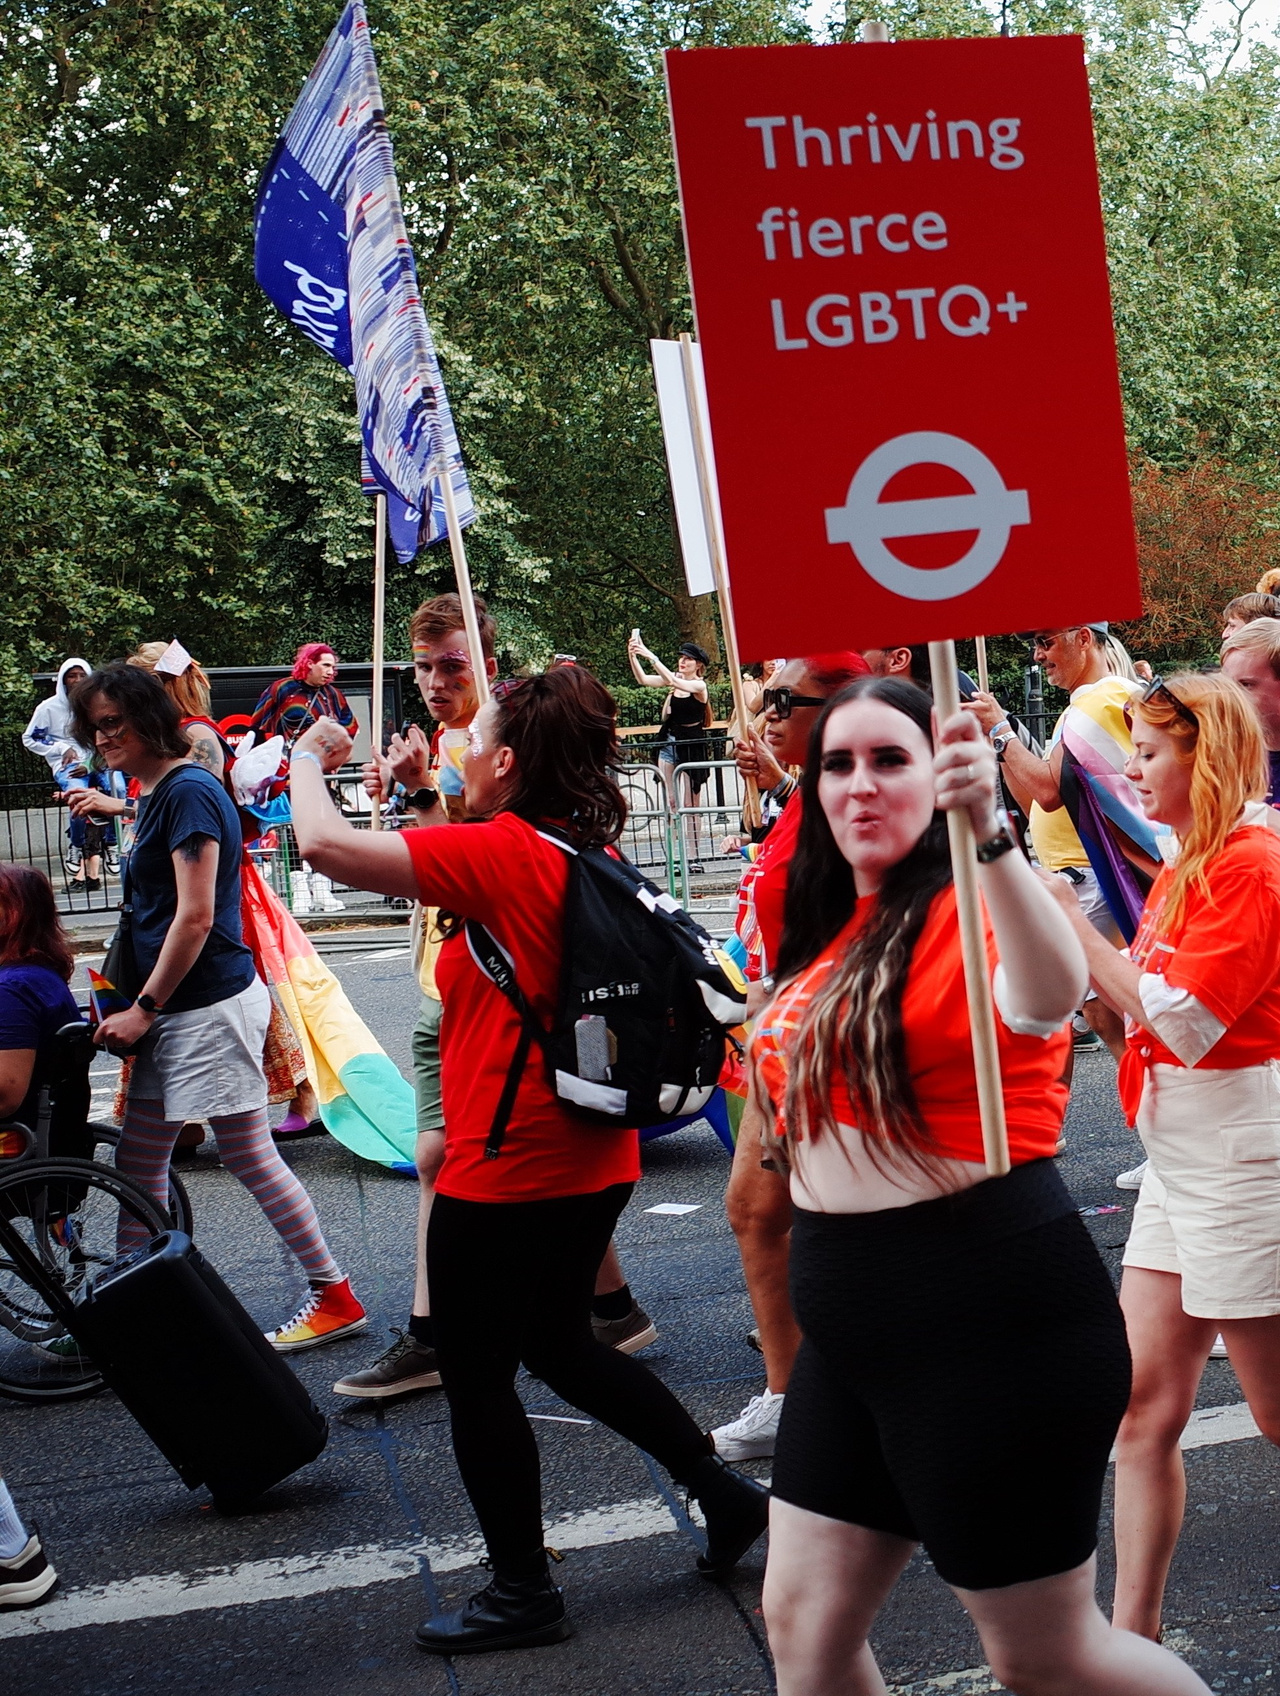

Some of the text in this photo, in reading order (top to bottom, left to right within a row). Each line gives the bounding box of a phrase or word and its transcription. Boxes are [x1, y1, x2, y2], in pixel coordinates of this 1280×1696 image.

[745, 109, 1025, 170] Thriving
[757, 207, 948, 261] fierce
[770, 284, 1028, 351] LGBTQ+
